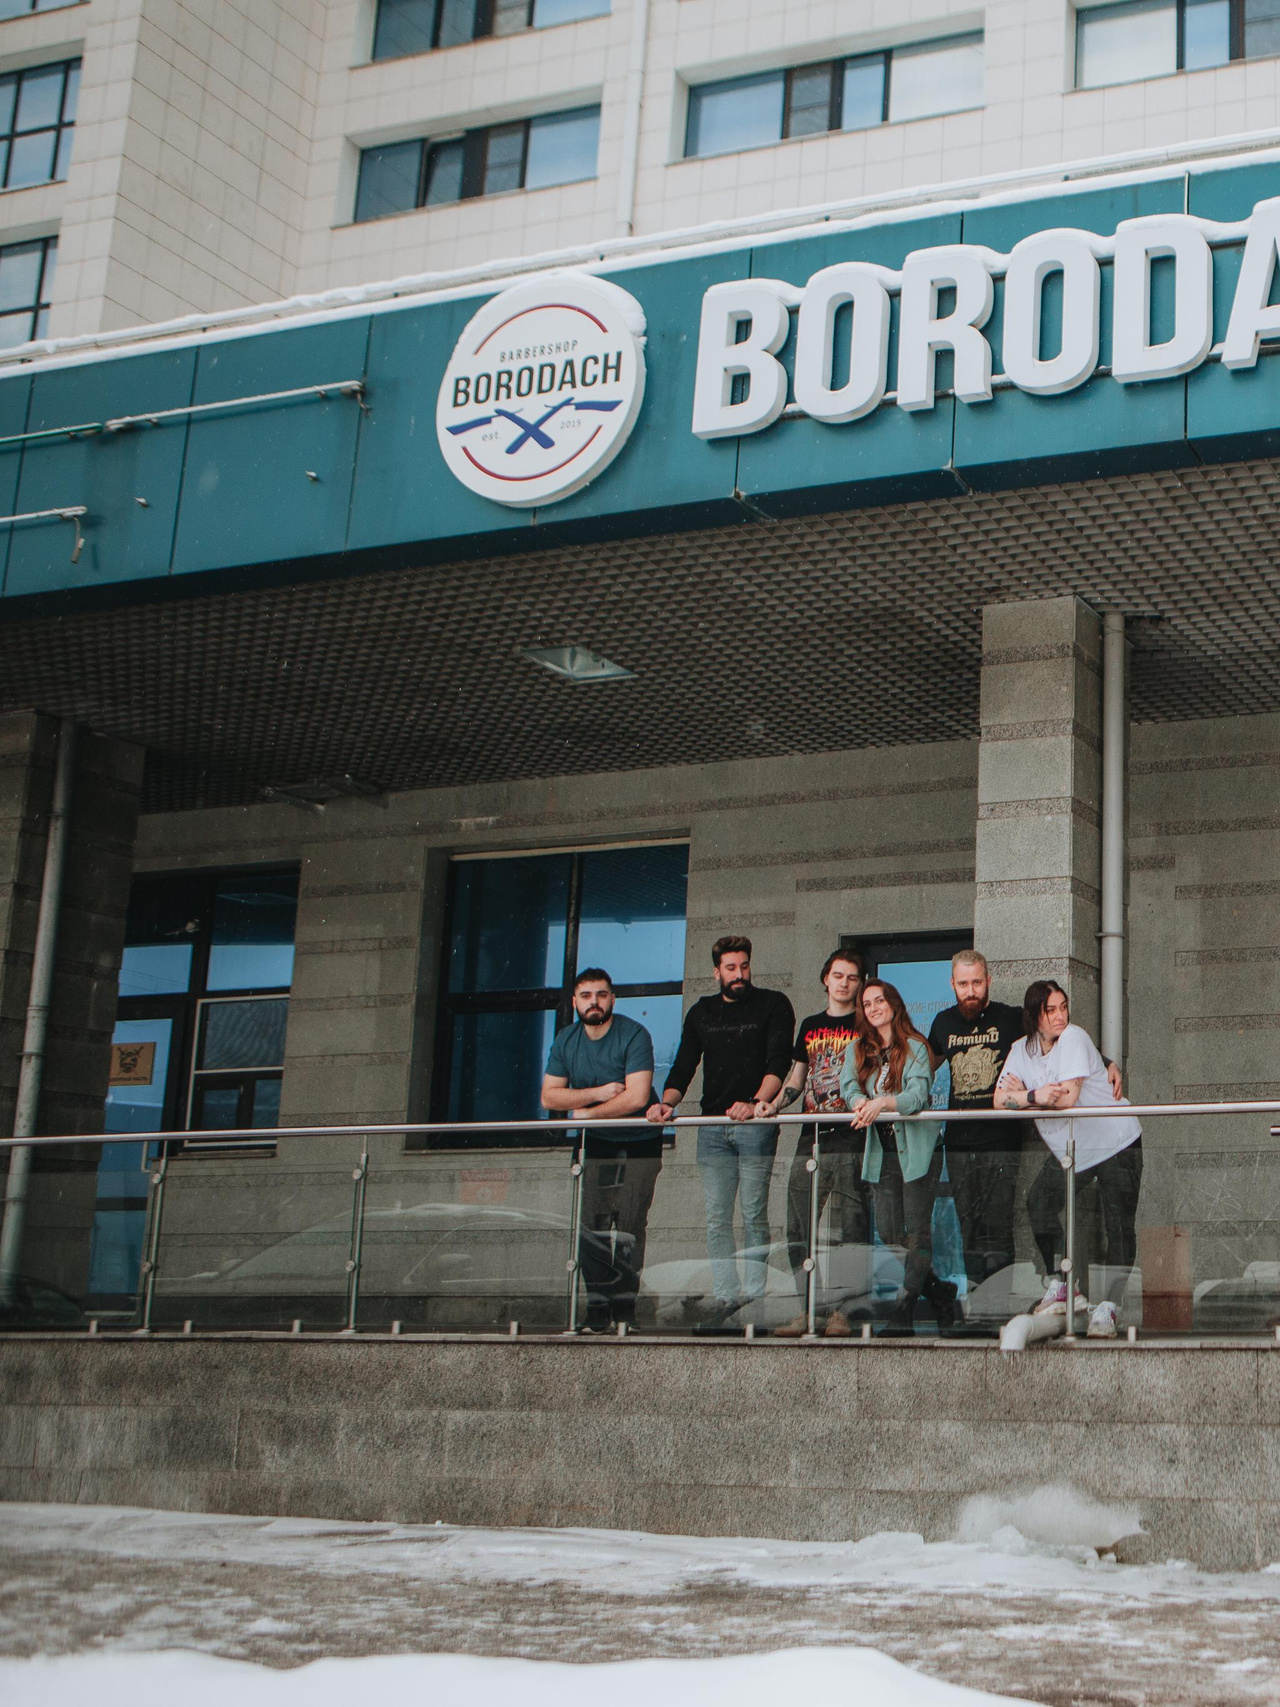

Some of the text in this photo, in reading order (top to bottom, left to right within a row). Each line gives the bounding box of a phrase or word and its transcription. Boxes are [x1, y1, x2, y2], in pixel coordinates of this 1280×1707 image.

[499, 338, 578, 363] BARBERSHOP
[452, 350, 623, 409] BORODACH
[559, 418, 583, 430] 2015
